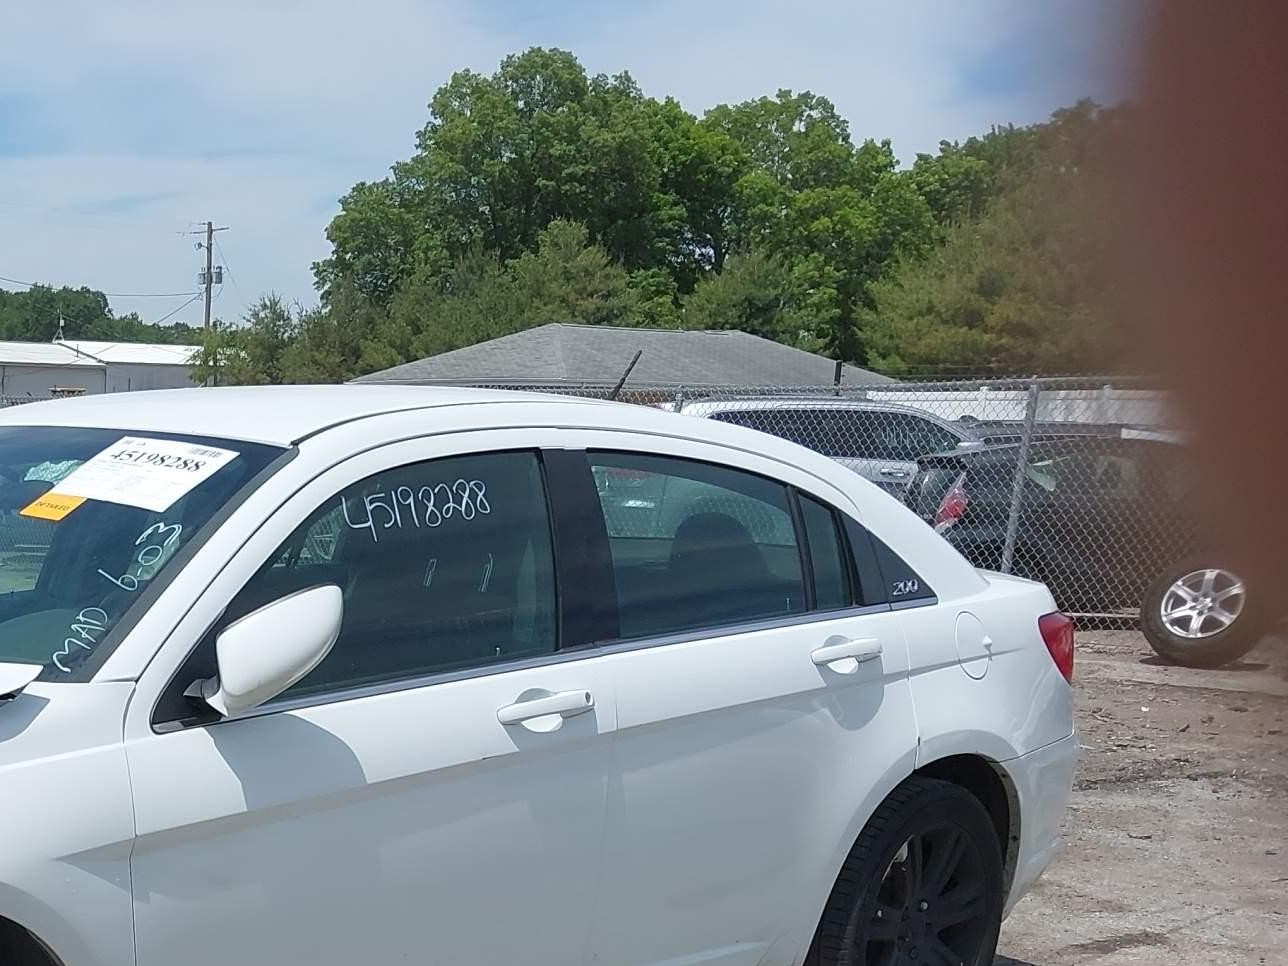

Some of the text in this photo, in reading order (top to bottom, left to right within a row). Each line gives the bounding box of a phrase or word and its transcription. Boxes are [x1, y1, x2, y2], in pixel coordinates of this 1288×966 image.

[110, 449, 207, 473] 45198288
[340, 478, 491, 543] 45198288
[52, 606, 109, 673] MAD
[96, 522, 183, 591] 6-03
[892, 579, 919, 596] 200
